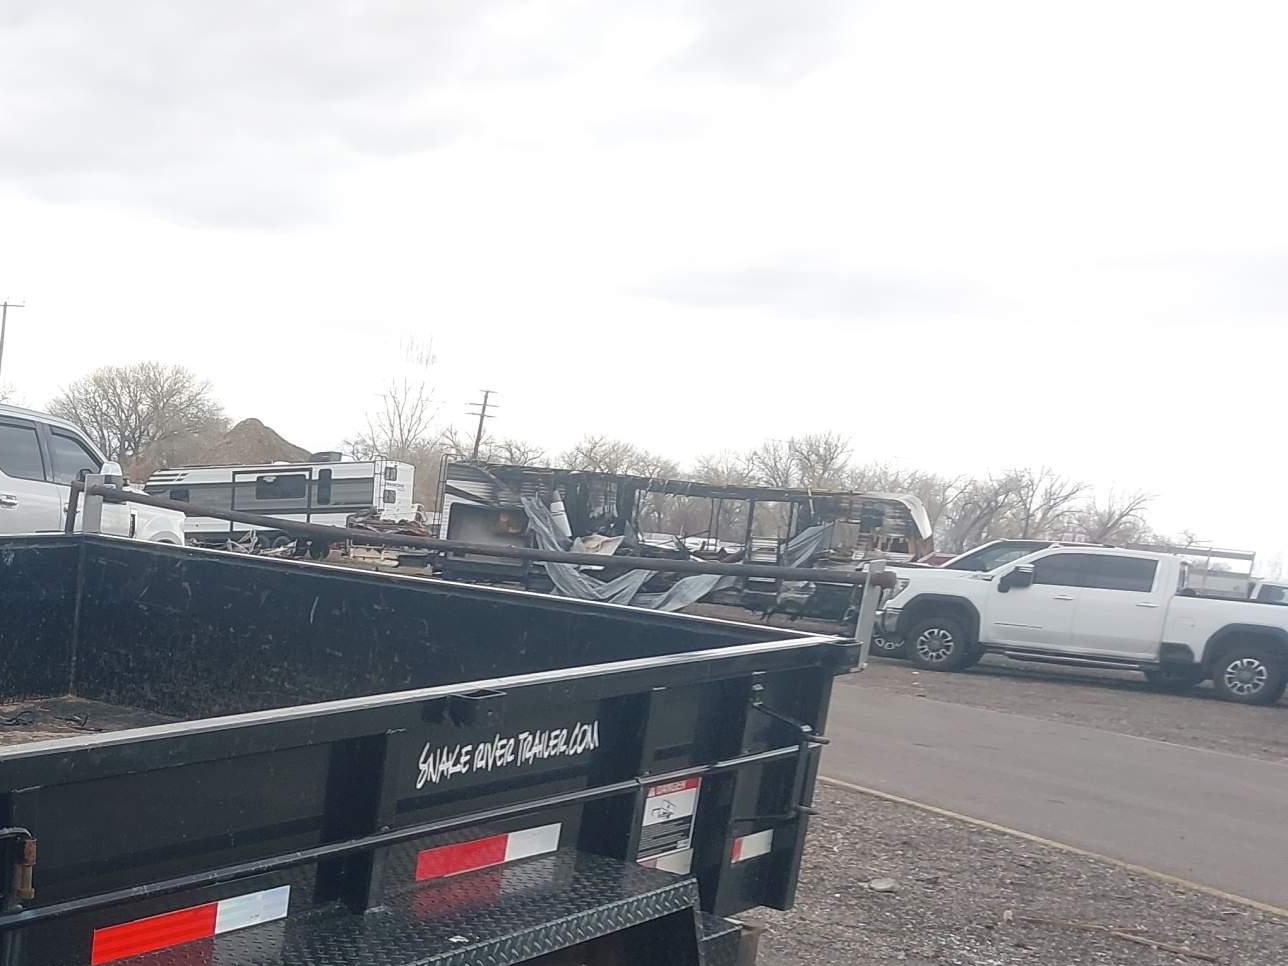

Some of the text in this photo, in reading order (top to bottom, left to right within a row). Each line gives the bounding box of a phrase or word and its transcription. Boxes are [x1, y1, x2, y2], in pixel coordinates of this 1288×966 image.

[415, 720, 600, 790] SNAKE RIVER TRAILER.COM
